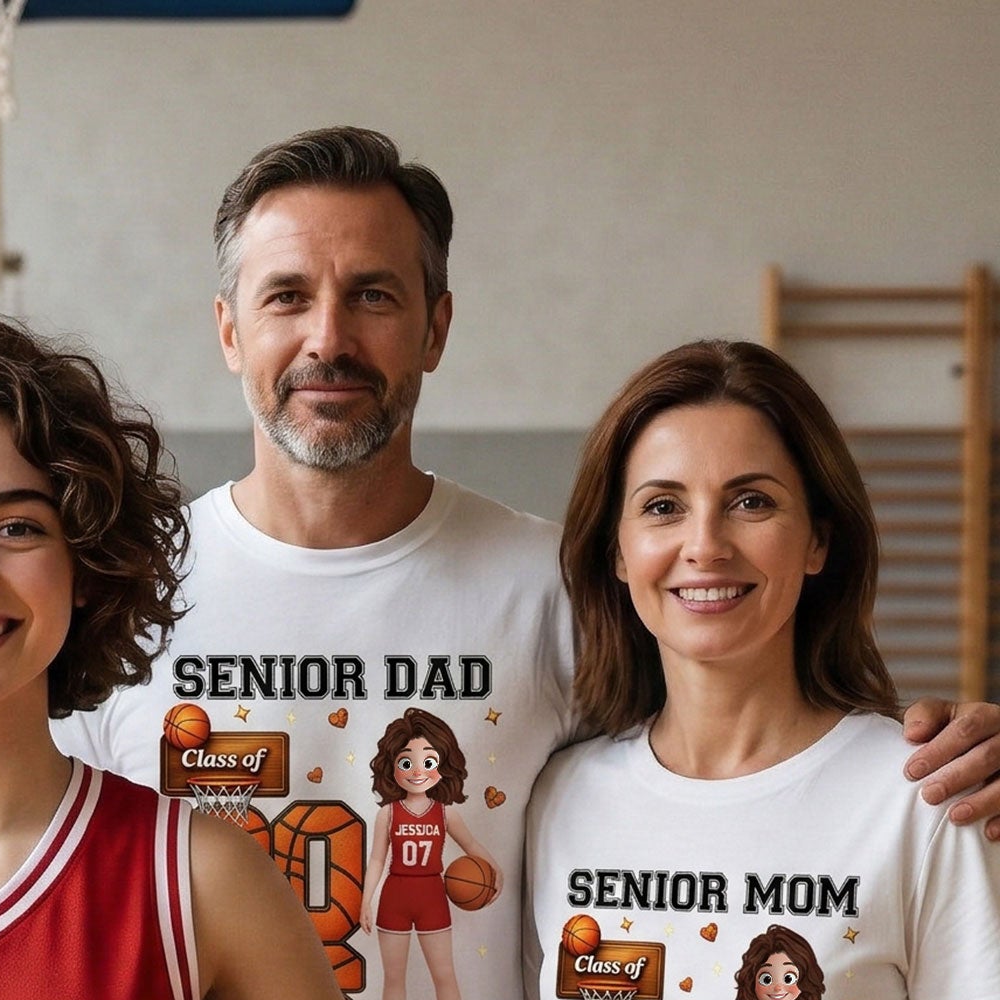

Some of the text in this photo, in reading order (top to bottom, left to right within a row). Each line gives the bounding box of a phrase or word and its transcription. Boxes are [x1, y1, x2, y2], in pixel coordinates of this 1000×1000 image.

[172, 654, 494, 701] SENIOR DAD
[181, 748, 268, 774] Class of
[402, 840, 433, 867] 07
[567, 868, 861, 918] SENIOR MOM
[574, 954, 647, 981] Class of
